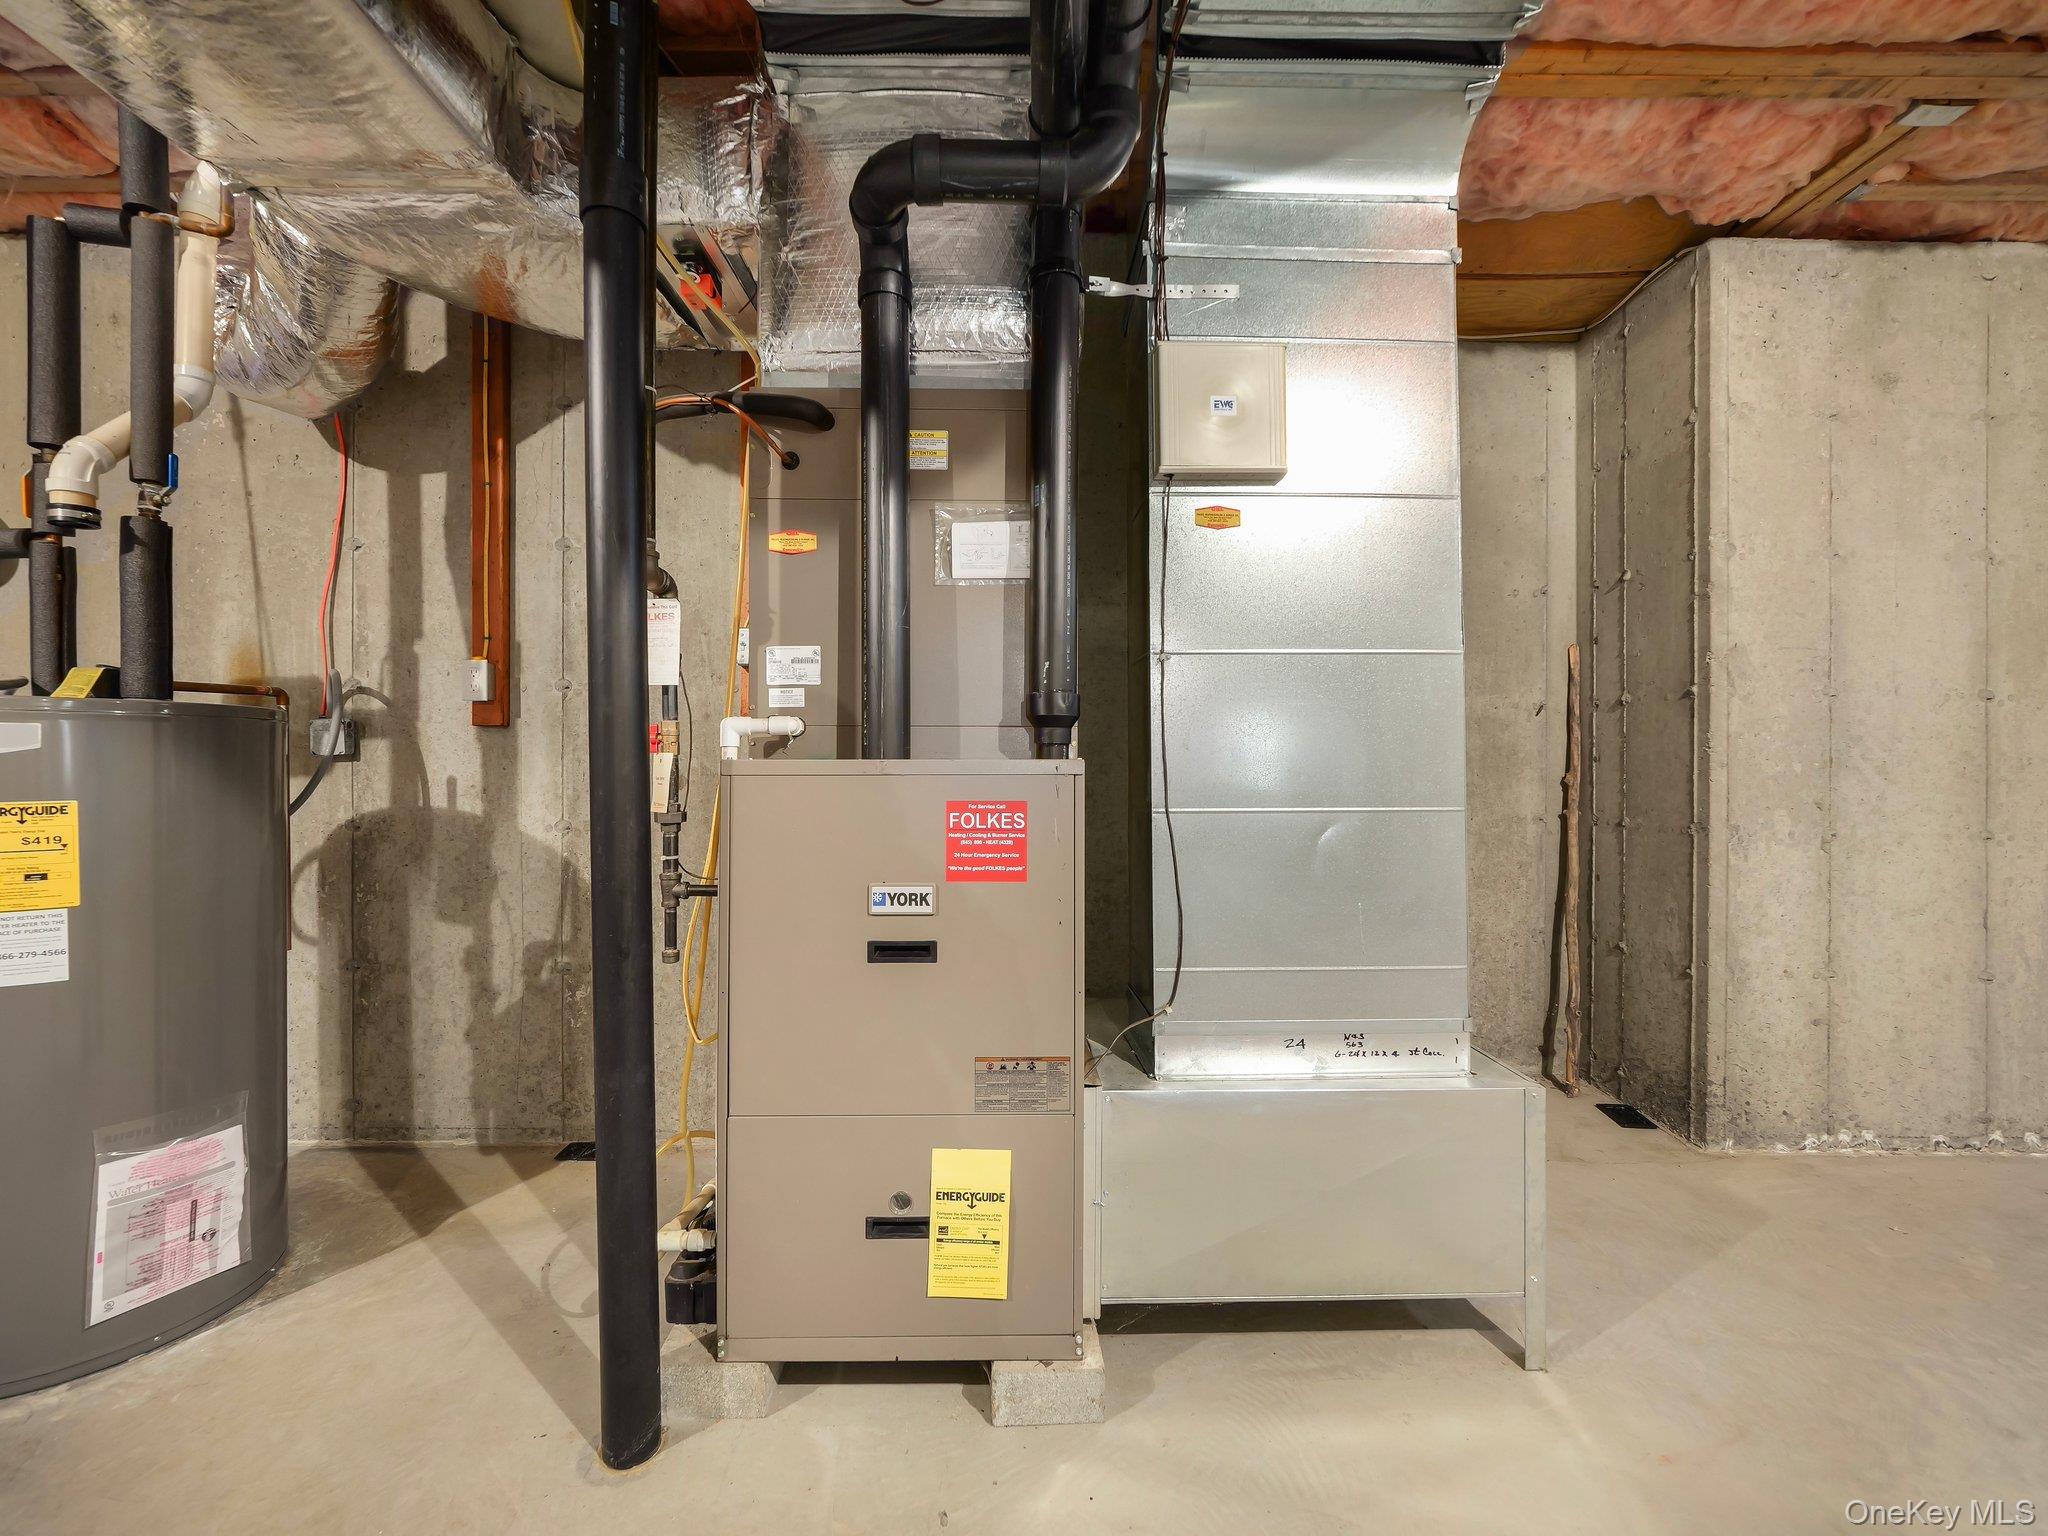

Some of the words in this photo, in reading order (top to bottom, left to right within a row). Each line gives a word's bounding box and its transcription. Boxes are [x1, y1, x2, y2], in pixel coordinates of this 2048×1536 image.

[949, 812, 1025, 829] FOLKES
[886, 892, 931, 907] YORK
[24, 926, 61, 935] PURCHASE
[1283, 1038, 1306, 1050] 24
[935, 1191, 1006, 1203] ENERGYGUIDE
